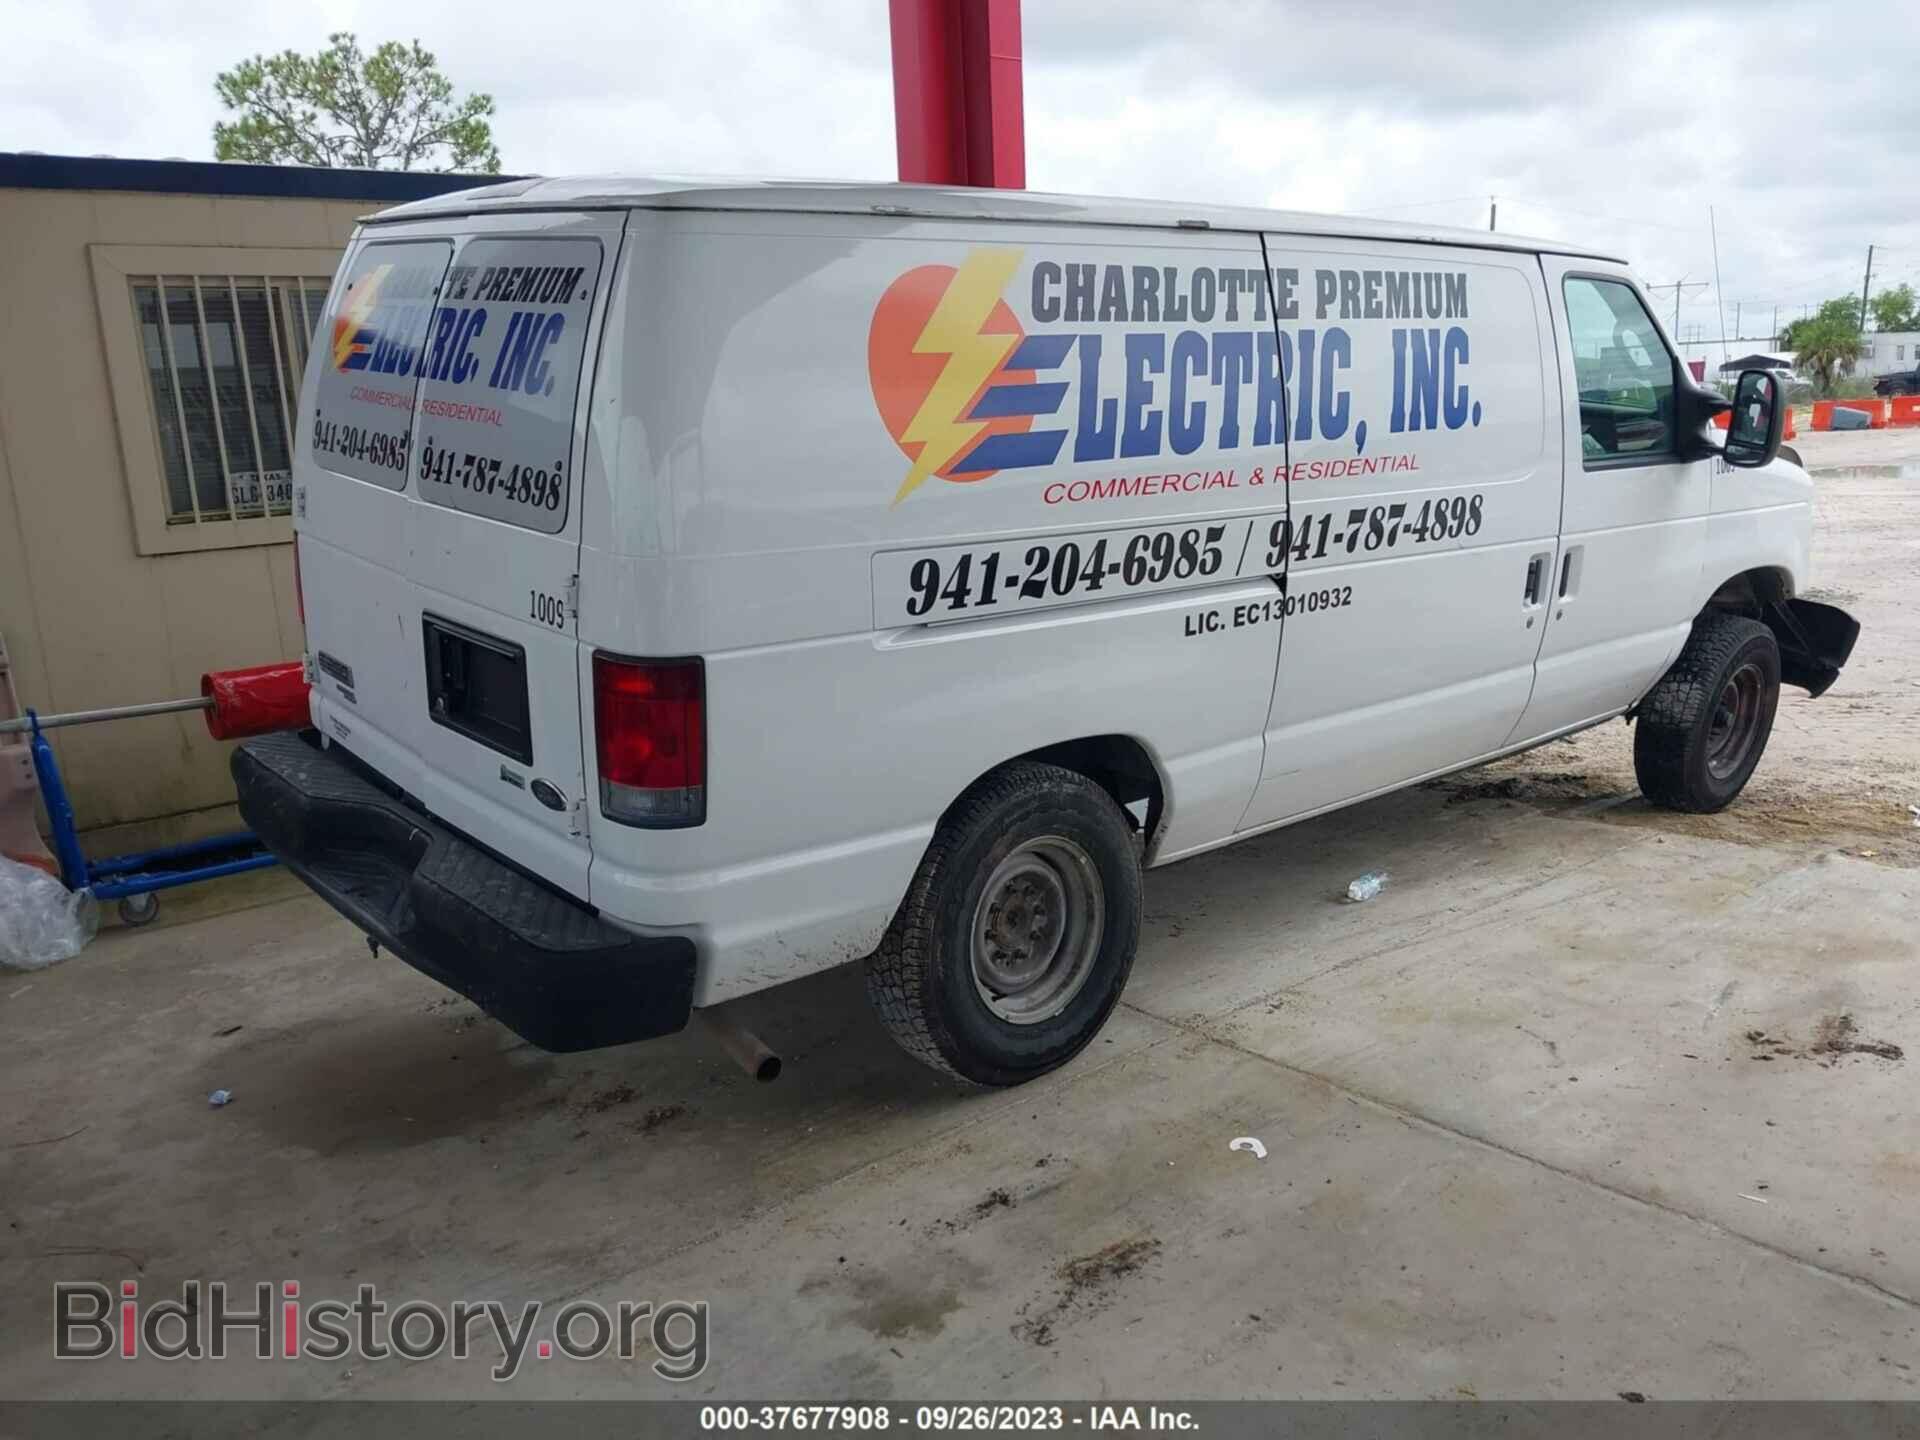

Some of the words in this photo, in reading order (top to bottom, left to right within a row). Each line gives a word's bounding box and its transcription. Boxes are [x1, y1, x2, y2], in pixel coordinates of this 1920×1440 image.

[473, 266, 586, 304] PREMIUM
[1031, 261, 1299, 323] CHARLOTTE
[1316, 271, 1468, 320] PREMIUM
[488, 311, 565, 397] INC.
[419, 398, 504, 427] RESIDENTIAL
[946, 326, 1369, 475] ELECTRIC,
[1390, 326, 1483, 433] INC.
[312, 419, 406, 472] 941-204-6985
[420, 443, 563, 511] 941-787-4898
[1043, 468, 1240, 504] COMMERCIAL
[1248, 466, 1265, 486] &
[1274, 453, 1420, 485] RESIDENTIAL
[905, 524, 1226, 617] 941-204-6985
[1265, 494, 1484, 567] 941-787-4898
[530, 590, 565, 629] 1009
[1184, 609, 1226, 637] LIC.
[1233, 585, 1353, 627] EC13010932
